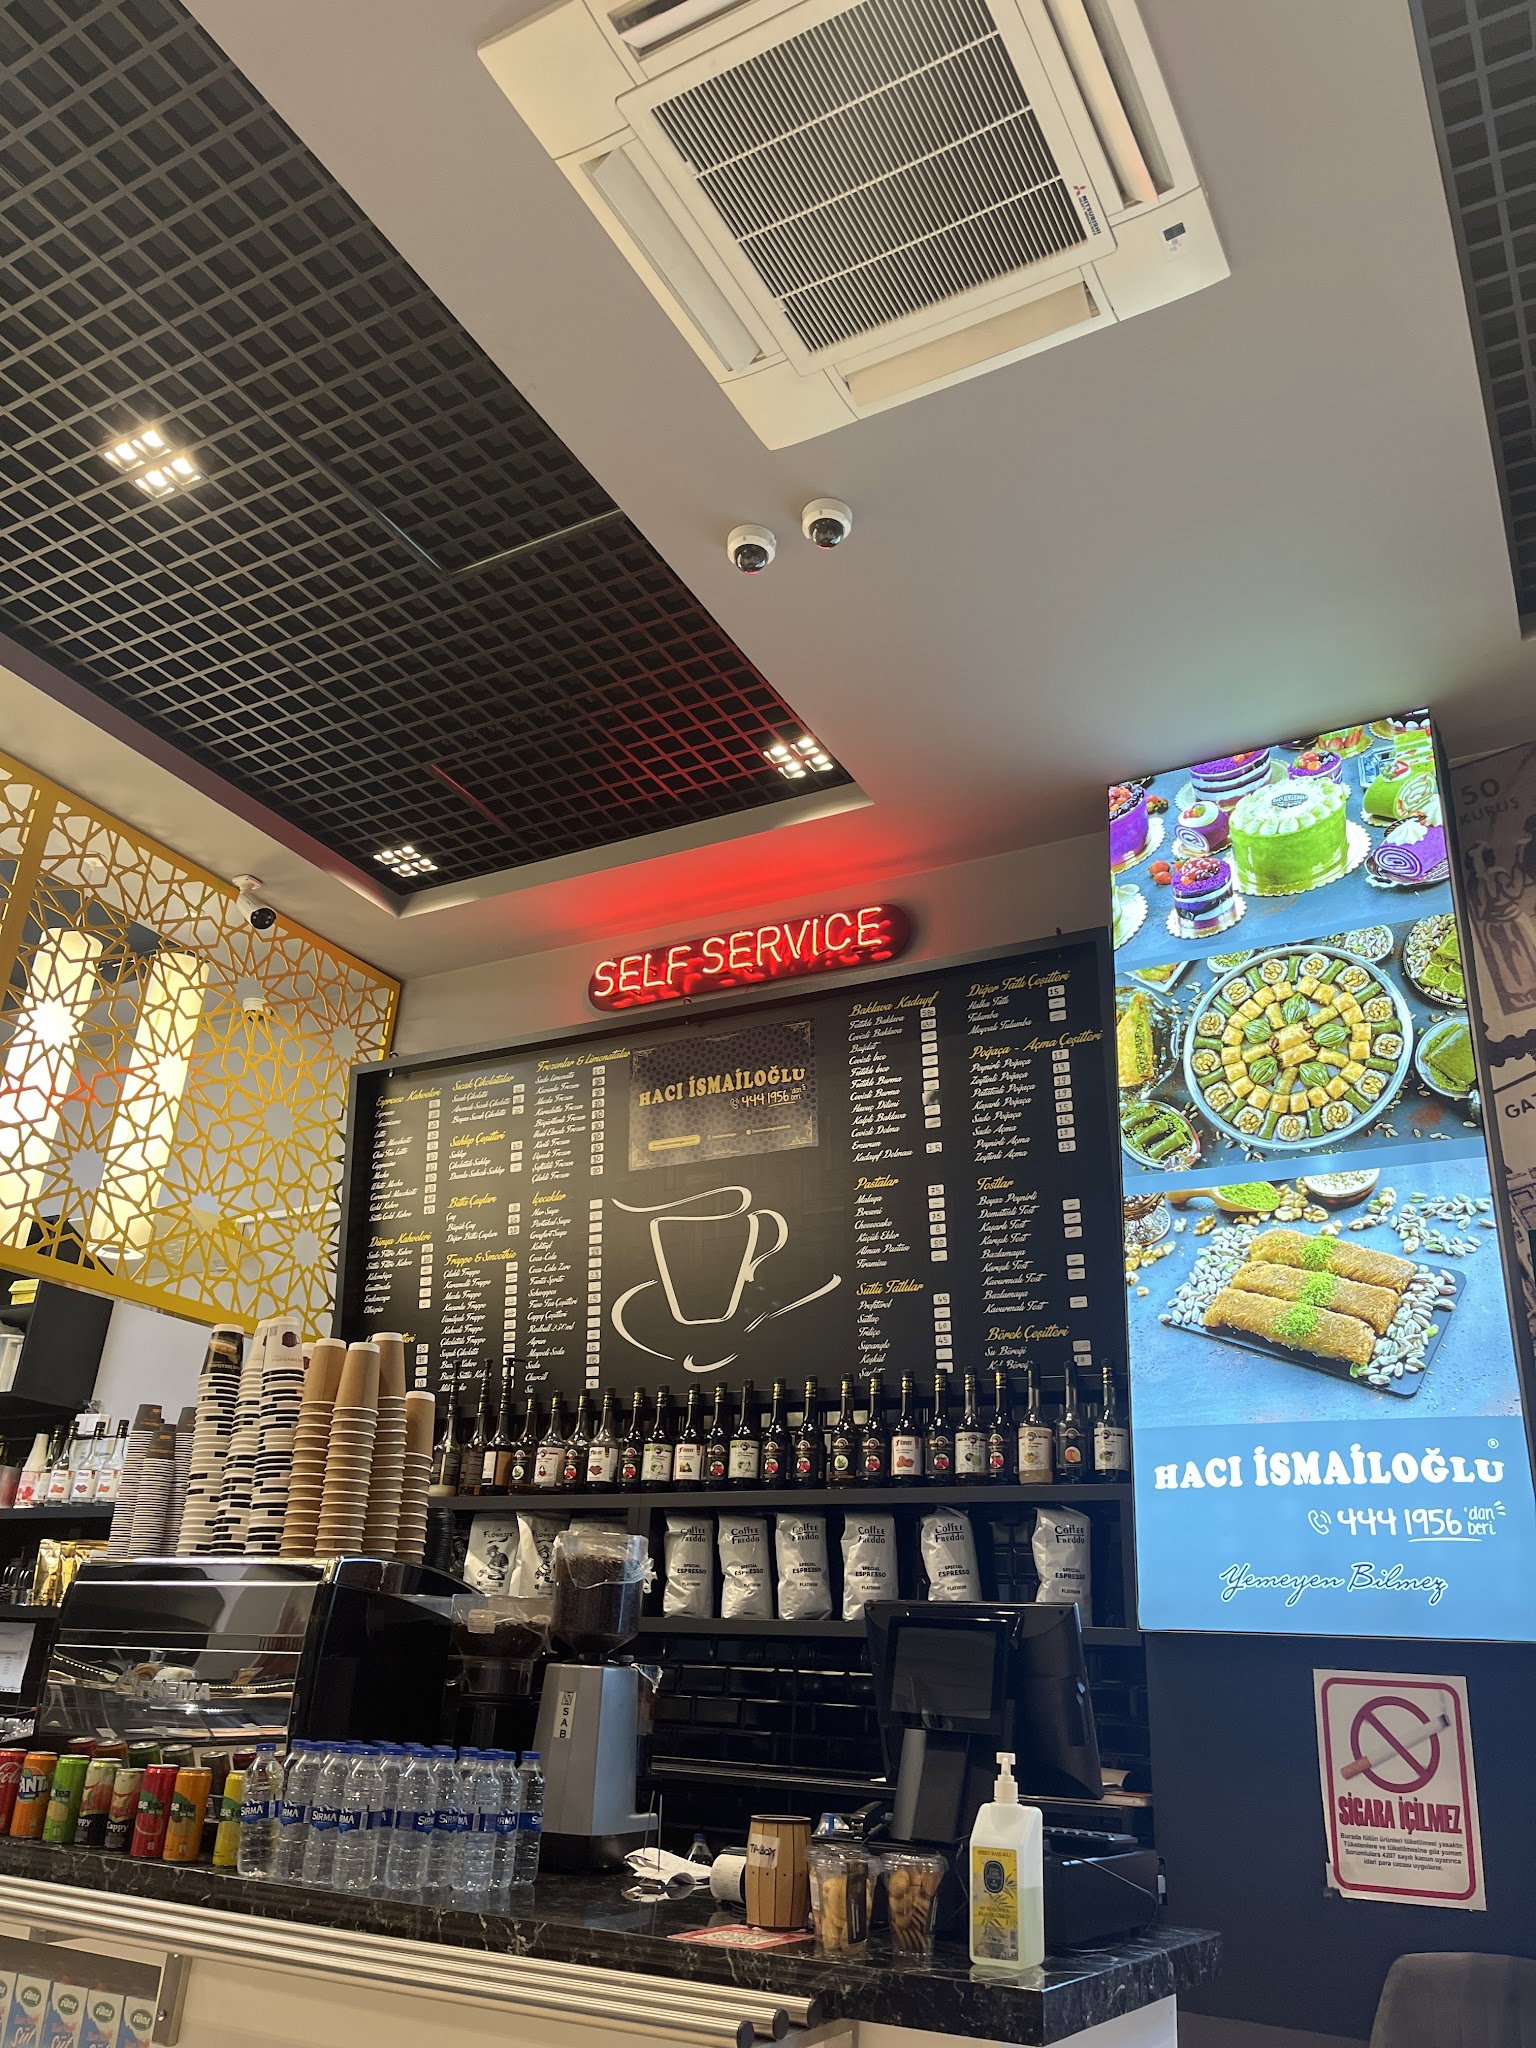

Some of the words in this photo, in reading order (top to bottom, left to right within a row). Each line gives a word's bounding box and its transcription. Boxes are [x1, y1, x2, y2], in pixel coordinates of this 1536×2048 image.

[1082, 195, 1102, 234] MITSUBISHI
[1462, 778, 1500, 805] 50
[593, 945, 692, 997] SELF
[702, 906, 883, 975] SERVICE
[966, 984, 999, 998] Diğer
[848, 1000, 894, 1017] Baklava
[895, 991, 940, 1009] Kadayıf
[873, 1014, 905, 1026] Baklava
[873, 1027, 904, 1038] Baklava
[969, 1045, 1012, 1060] Poğaça
[1022, 1037, 1058, 1053] Açma
[1001, 1058, 1032, 1070] Poğaça
[638, 1082, 683, 1107] HACI
[688, 1065, 806, 1098] İSMAİLOĞLU
[741, 1092, 764, 1108] 444
[767, 1090, 790, 1105] 1956
[1001, 1096, 1033, 1108] Poğaça
[993, 1123, 1017, 1134] Açma
[853, 1174, 899, 1191] Pastalar
[976, 1175, 1014, 1191] Tostlar
[1018, 1204, 1040, 1216] Tost
[1009, 1219, 1031, 1230] Tost
[1010, 1232, 1032, 1243] Tost
[1012, 1260, 1034, 1271] Tost
[1025, 1272, 1047, 1283] Tost
[856, 1281, 883, 1296] Sütlü
[1026, 1300, 1049, 1311] Tost
[984, 1325, 1023, 1341] Börek
[985, 1346, 997, 1357] Su
[1154, 1455, 1243, 1490] HACI
[1253, 1443, 1505, 1488] İSMAİLOĞLU
[1336, 1507, 1397, 1536] 444
[1404, 1507, 1462, 1536] 1956
[938, 1570, 970, 1578] ESPRESSO
[1055, 1572, 1085, 1580] ESPRESSO
[1219, 1562, 1345, 1607] Yemeyen
[1346, 1561, 1449, 1606] Bilmez
[1338, 1792, 1396, 1829] SİGARA
[1398, 1796, 1463, 1835] İÇİLMEZ
